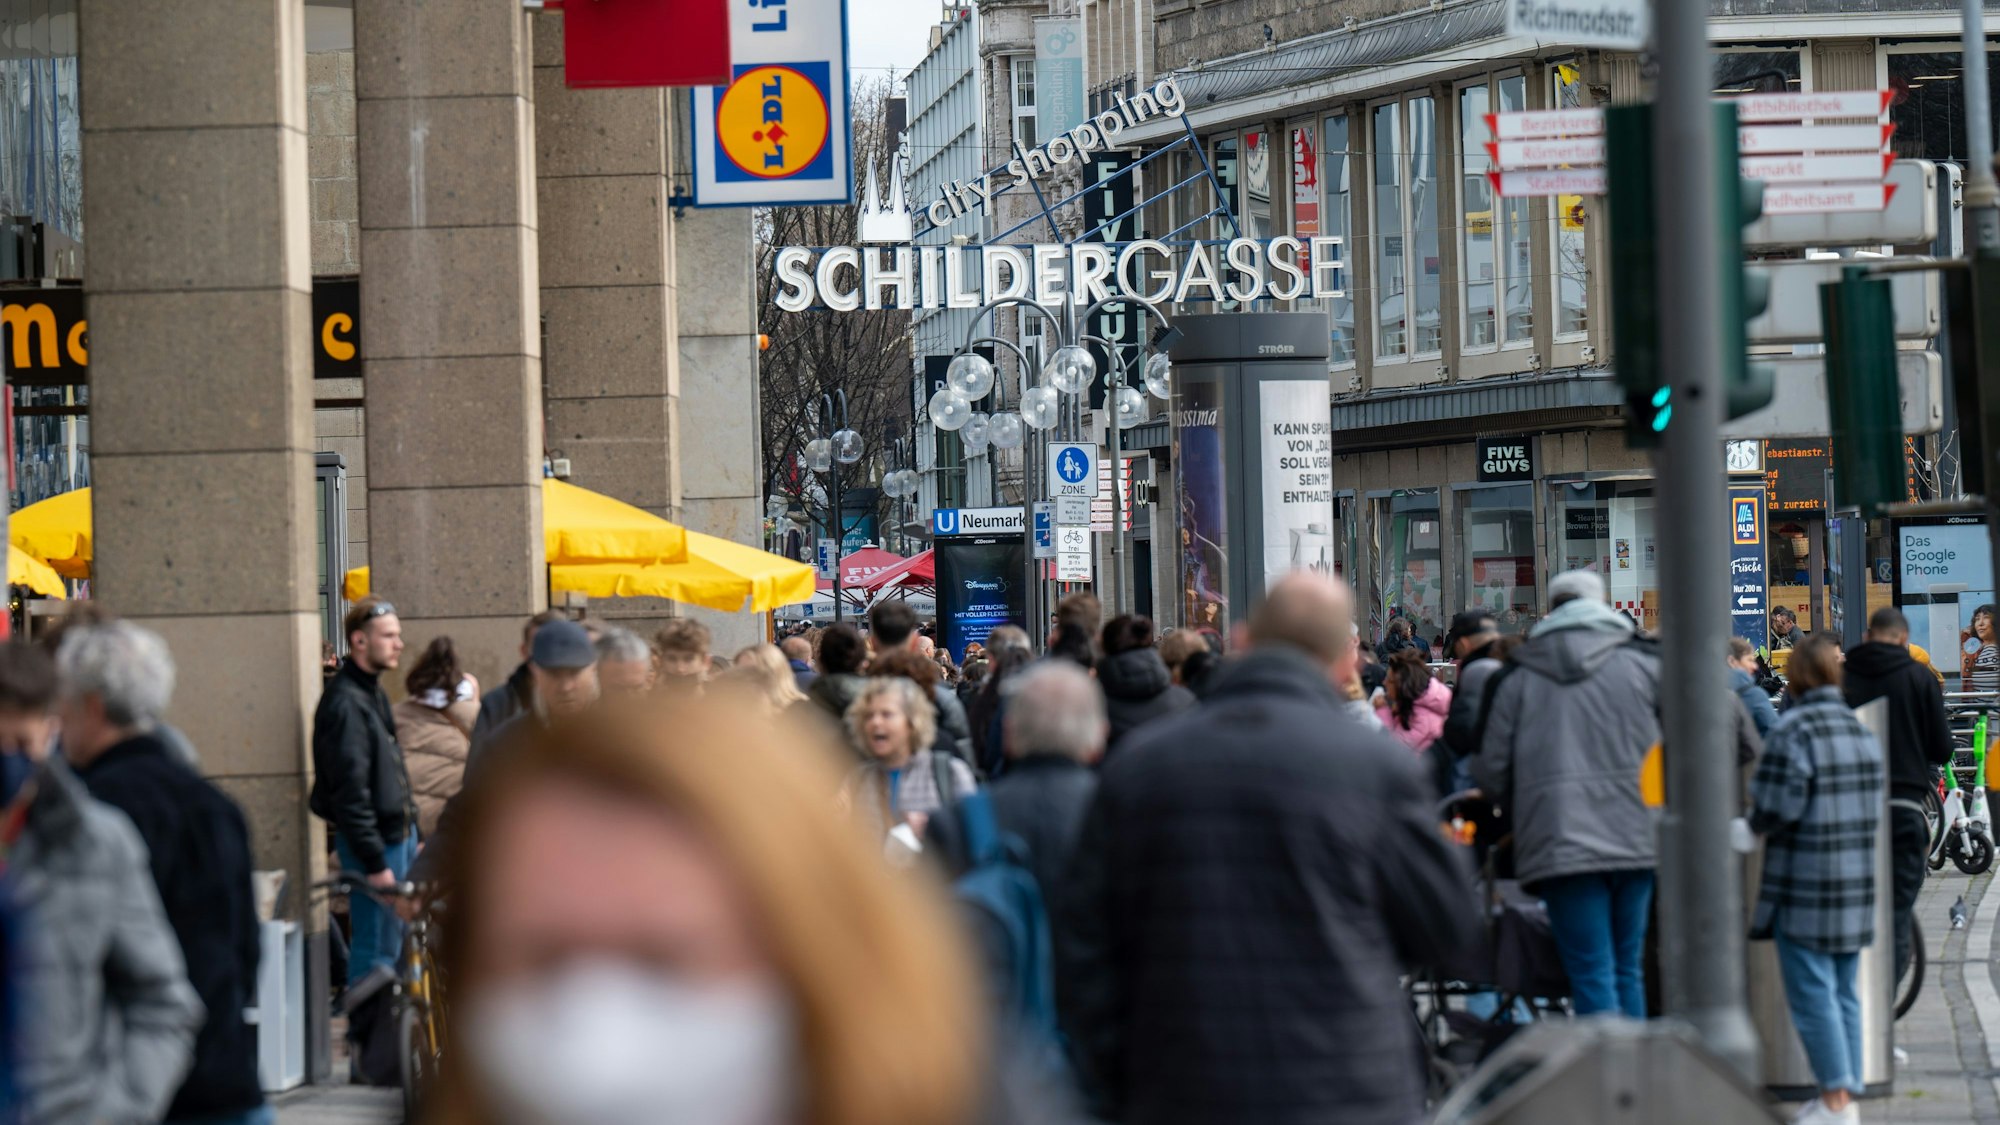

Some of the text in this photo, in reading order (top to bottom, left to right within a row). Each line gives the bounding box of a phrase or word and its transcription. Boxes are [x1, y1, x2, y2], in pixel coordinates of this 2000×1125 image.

[1048, 62, 1069, 138] ugenklinik
[1738, 99, 1843, 117] adtbibliothek
[1521, 117, 1606, 131] Bezirksreg
[928, 174, 991, 227] city
[1008, 76, 1186, 186] shopping
[1526, 175, 1606, 190] Stadtmus
[1764, 192, 1855, 208] ndheitsamt
[776, 235, 1346, 312] SCHILDERGASSE
[1258, 345, 1295, 353] STRÖER
[1274, 422, 1331, 435] KANN SPUR
[1287, 440, 1313, 452] VON
[1487, 446, 1525, 459] FIVE
[1767, 448, 1826, 458] ebastianstr.
[1280, 457, 1310, 469] SOLL
[1483, 459, 1530, 473] GUYS
[1061, 485, 1086, 494] ZONE
[1784, 500, 1819, 510] zurzeit
[963, 512, 1025, 529] Neumark
[1738, 524, 1755, 533] ALDI
[1905, 535, 1931, 547] Das
[1905, 549, 1956, 563] Google
[1730, 559, 1762, 575] Frische
[1906, 564, 1949, 576] Phone
[1733, 585, 1744, 593] Nur
[1744, 584, 1755, 593] 200
[817, 604, 831, 612] Café
[921, 602, 935, 610] Ries
[1645, 608, 1660, 617] FIV
